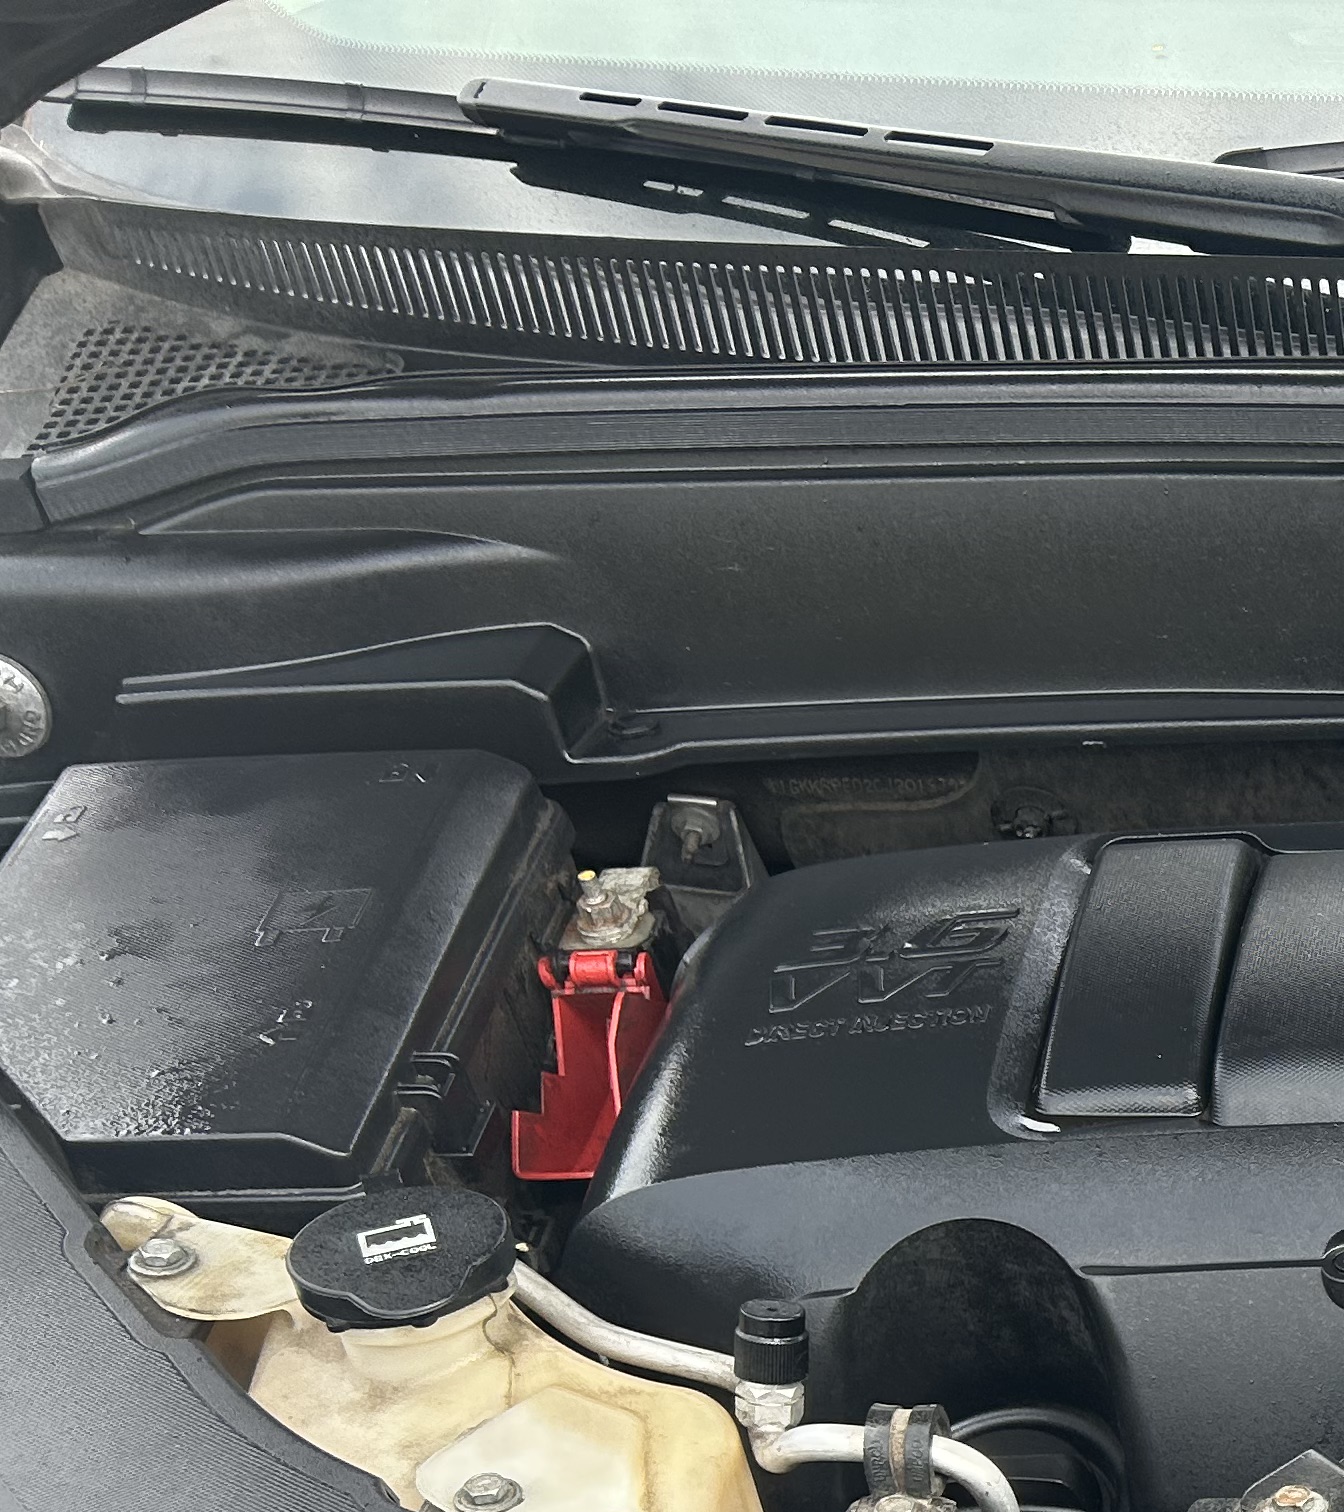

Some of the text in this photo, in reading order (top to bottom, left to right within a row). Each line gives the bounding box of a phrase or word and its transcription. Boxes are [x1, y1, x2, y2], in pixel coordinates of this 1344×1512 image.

[768, 960, 1003, 1015] VVT
[744, 1003, 993, 1048] DIRECT INJECTION
[363, 1242, 438, 1265] DEX-COOL
